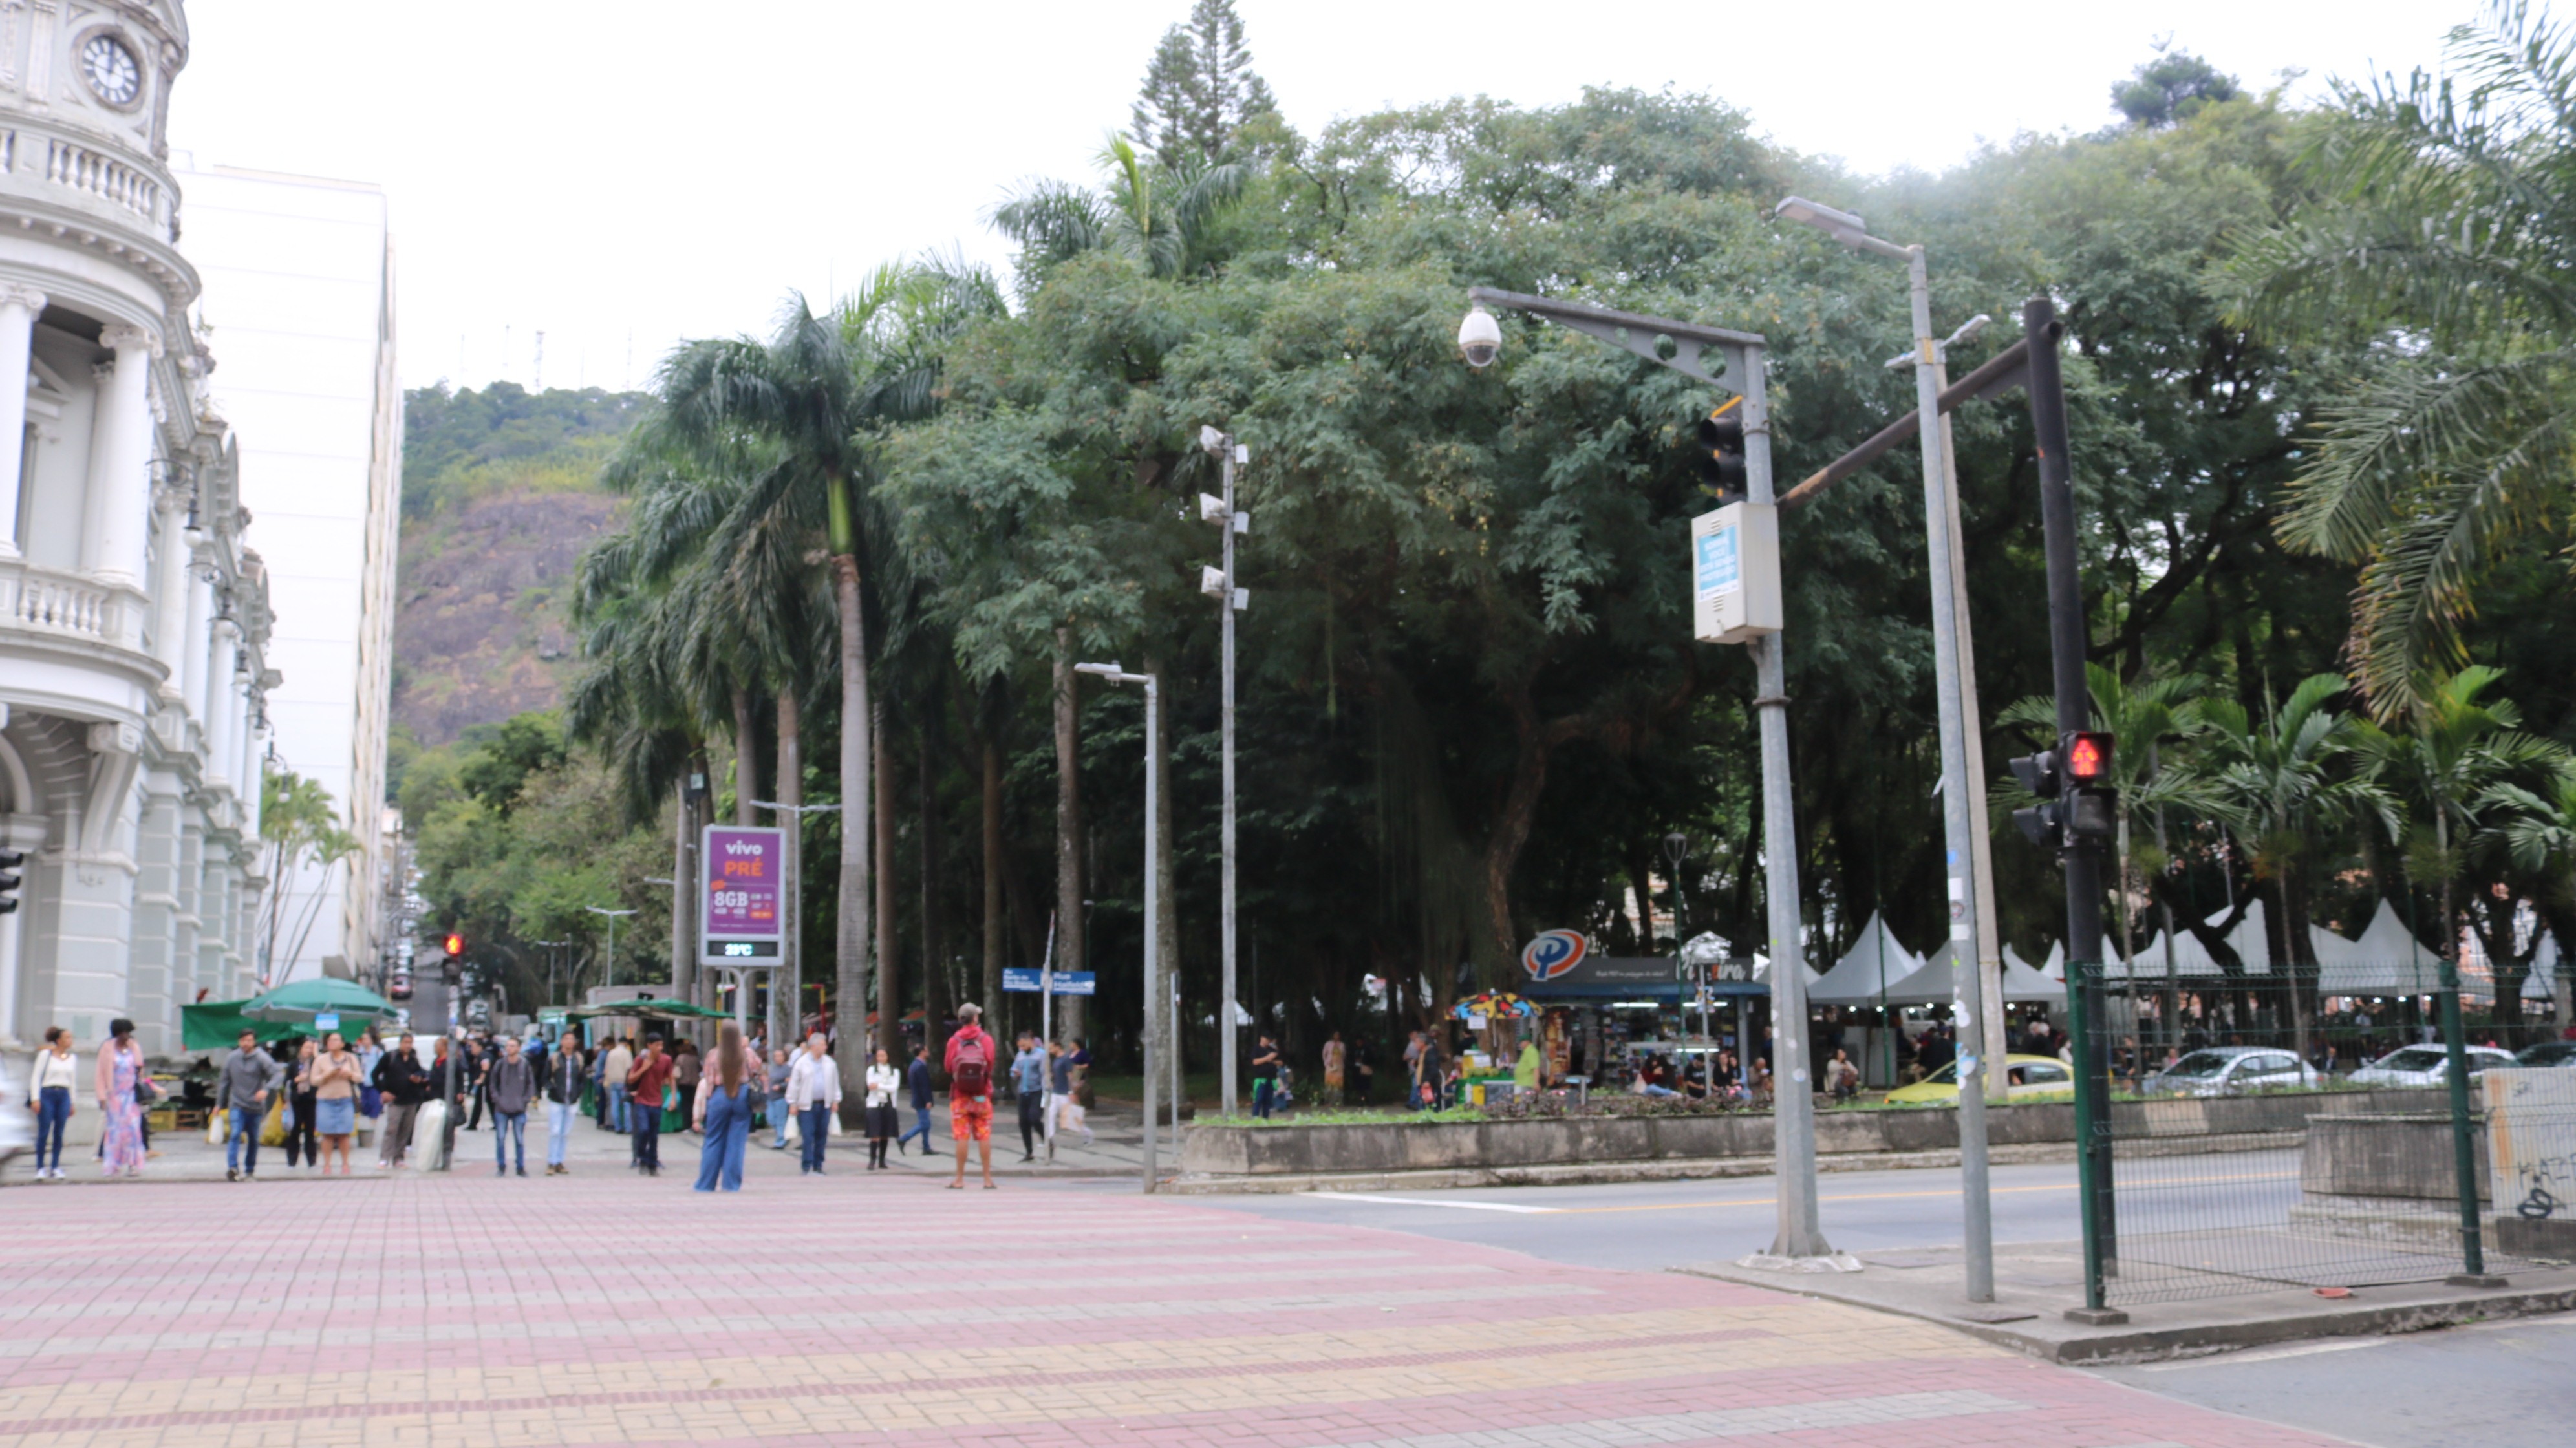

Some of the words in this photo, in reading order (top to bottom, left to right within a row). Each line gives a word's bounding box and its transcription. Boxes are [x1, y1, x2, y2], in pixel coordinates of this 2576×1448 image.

[725, 840, 763, 855] vivo
[725, 857, 763, 877] PRÉ
[714, 891, 749, 908] 8GB
